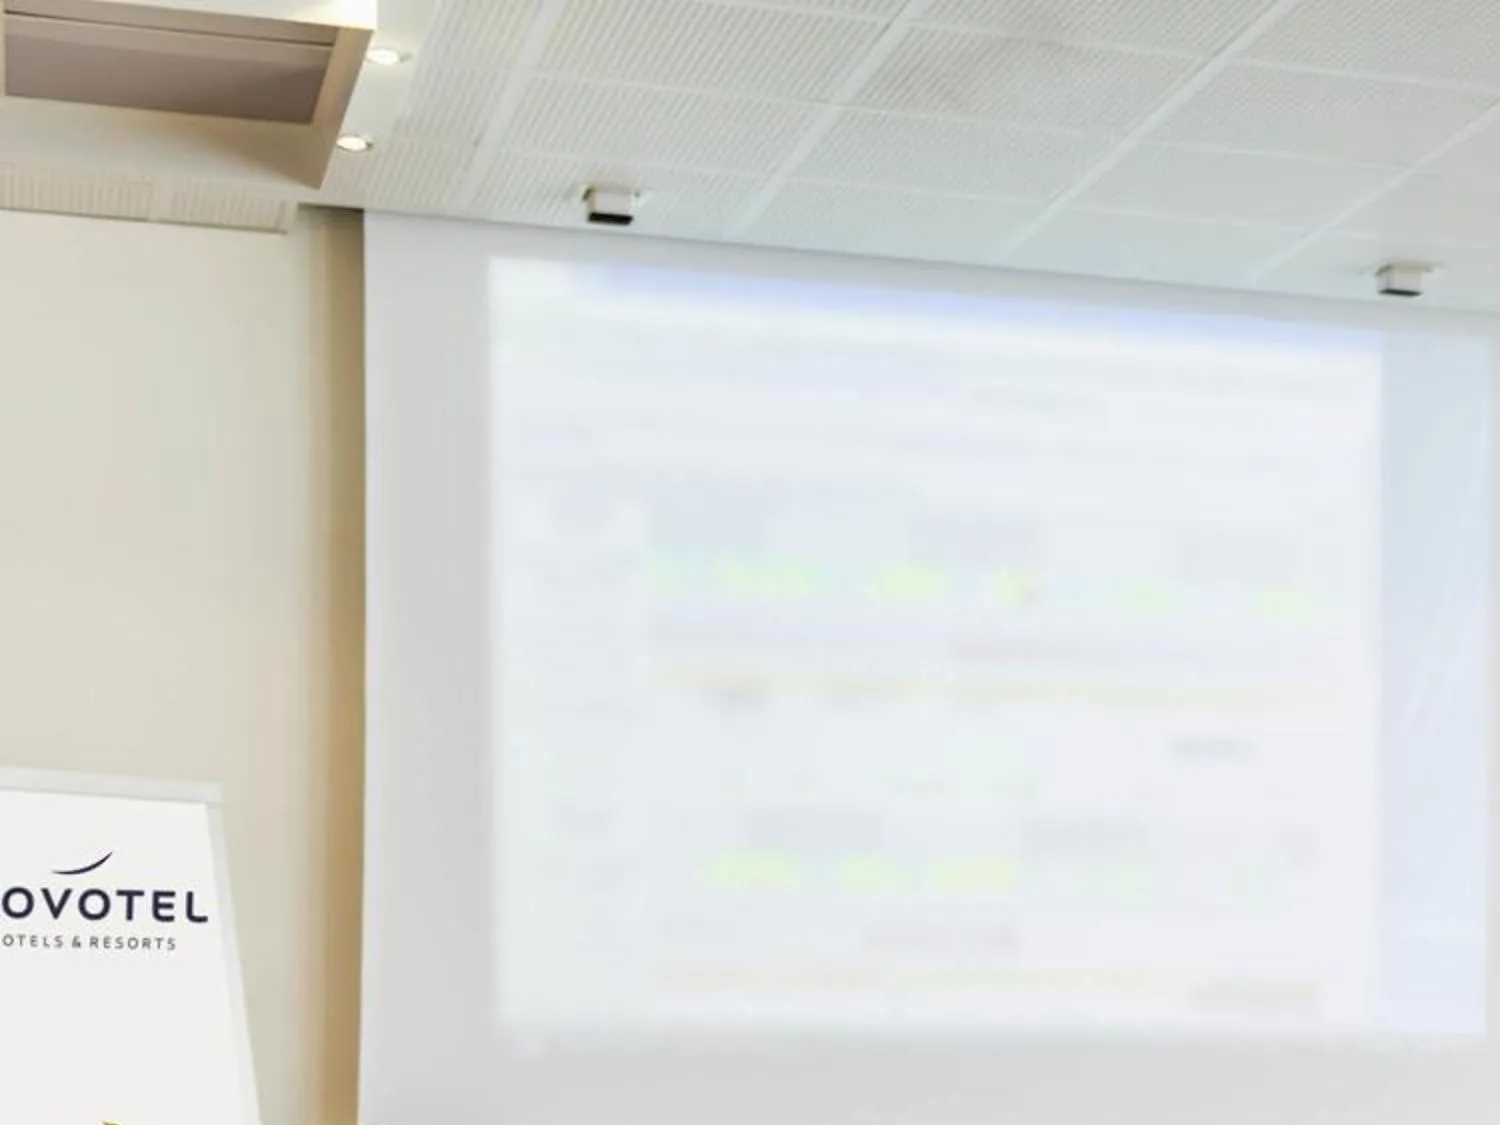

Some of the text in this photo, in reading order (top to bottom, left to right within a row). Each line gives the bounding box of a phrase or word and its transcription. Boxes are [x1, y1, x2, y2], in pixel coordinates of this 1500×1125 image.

[0, 886, 208, 924] OVOTEL
[1, 932, 177, 952] OTELS & RESORTS
